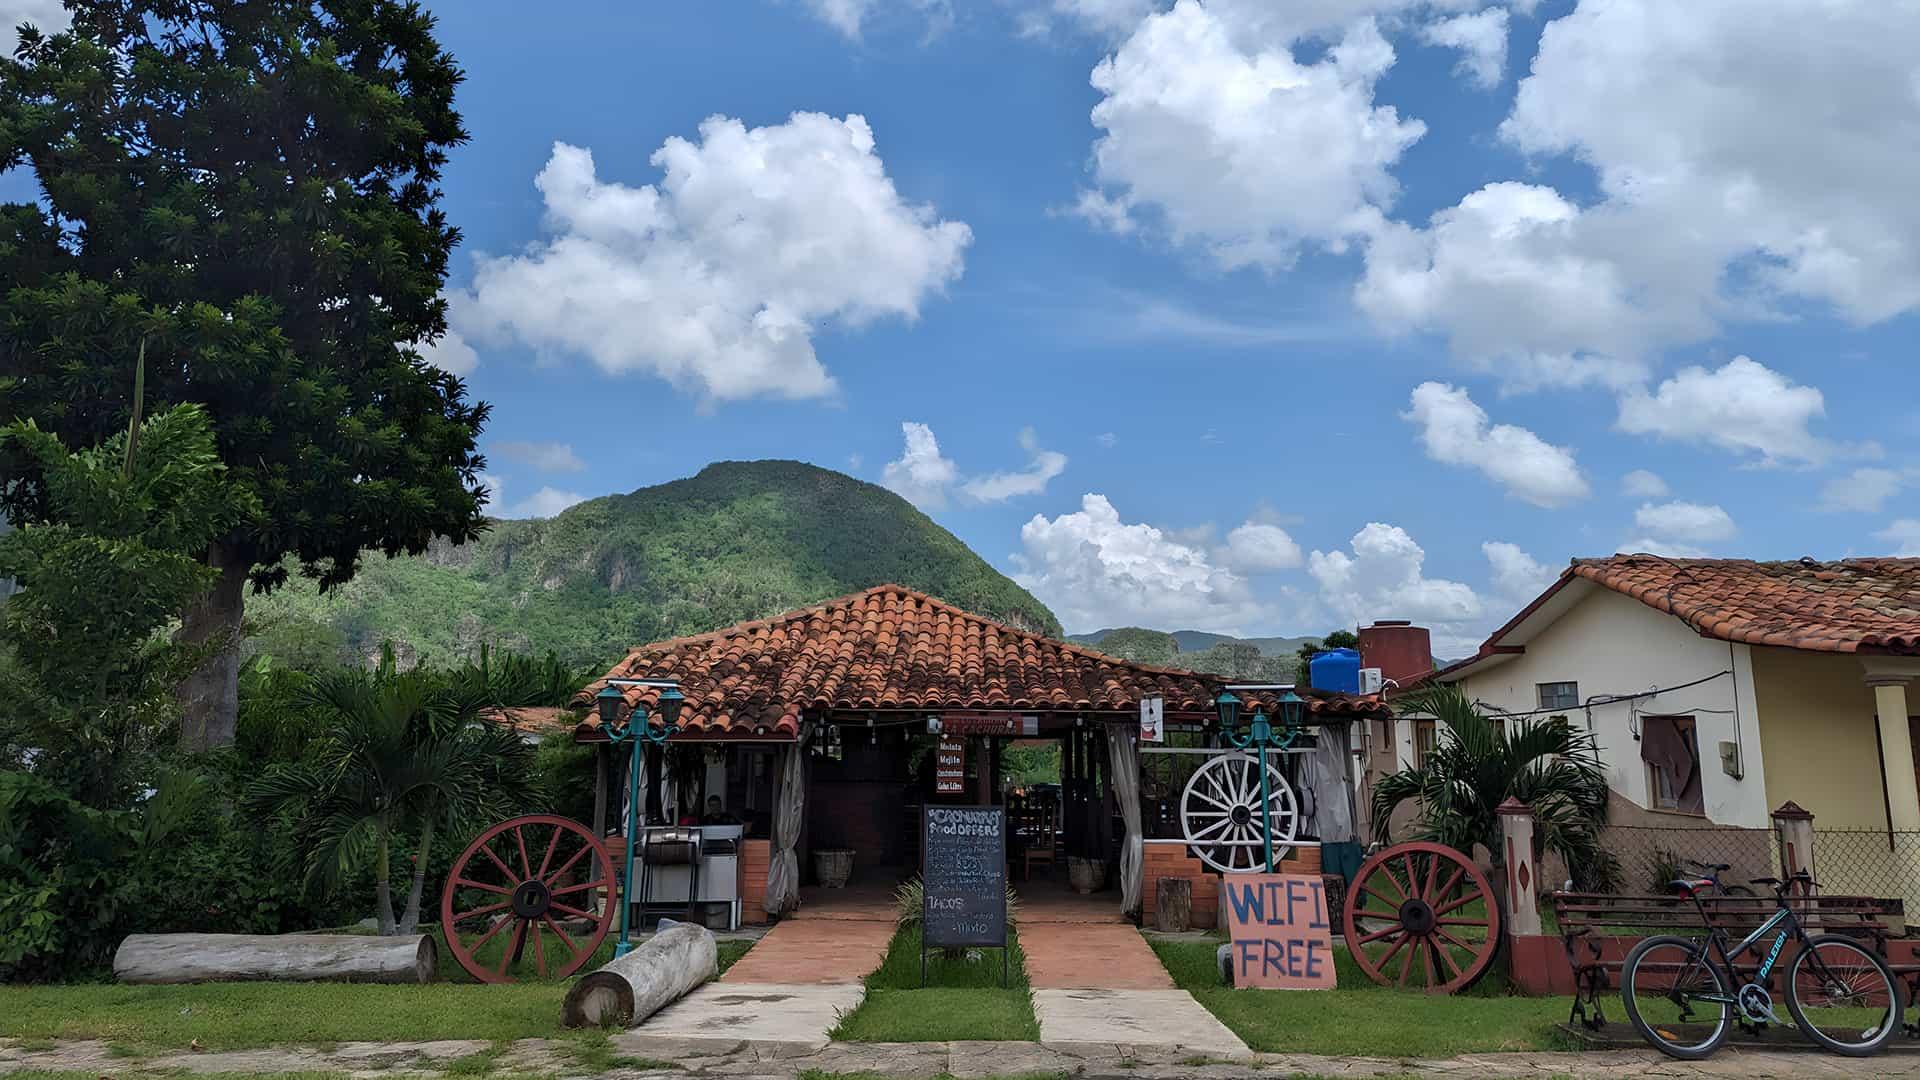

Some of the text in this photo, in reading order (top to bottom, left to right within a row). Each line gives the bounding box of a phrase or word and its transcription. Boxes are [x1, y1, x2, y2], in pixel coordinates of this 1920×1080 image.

[927, 895, 964, 910] TACOS
[1227, 880, 1329, 929] WIFI
[1234, 938, 1323, 978] FREE
